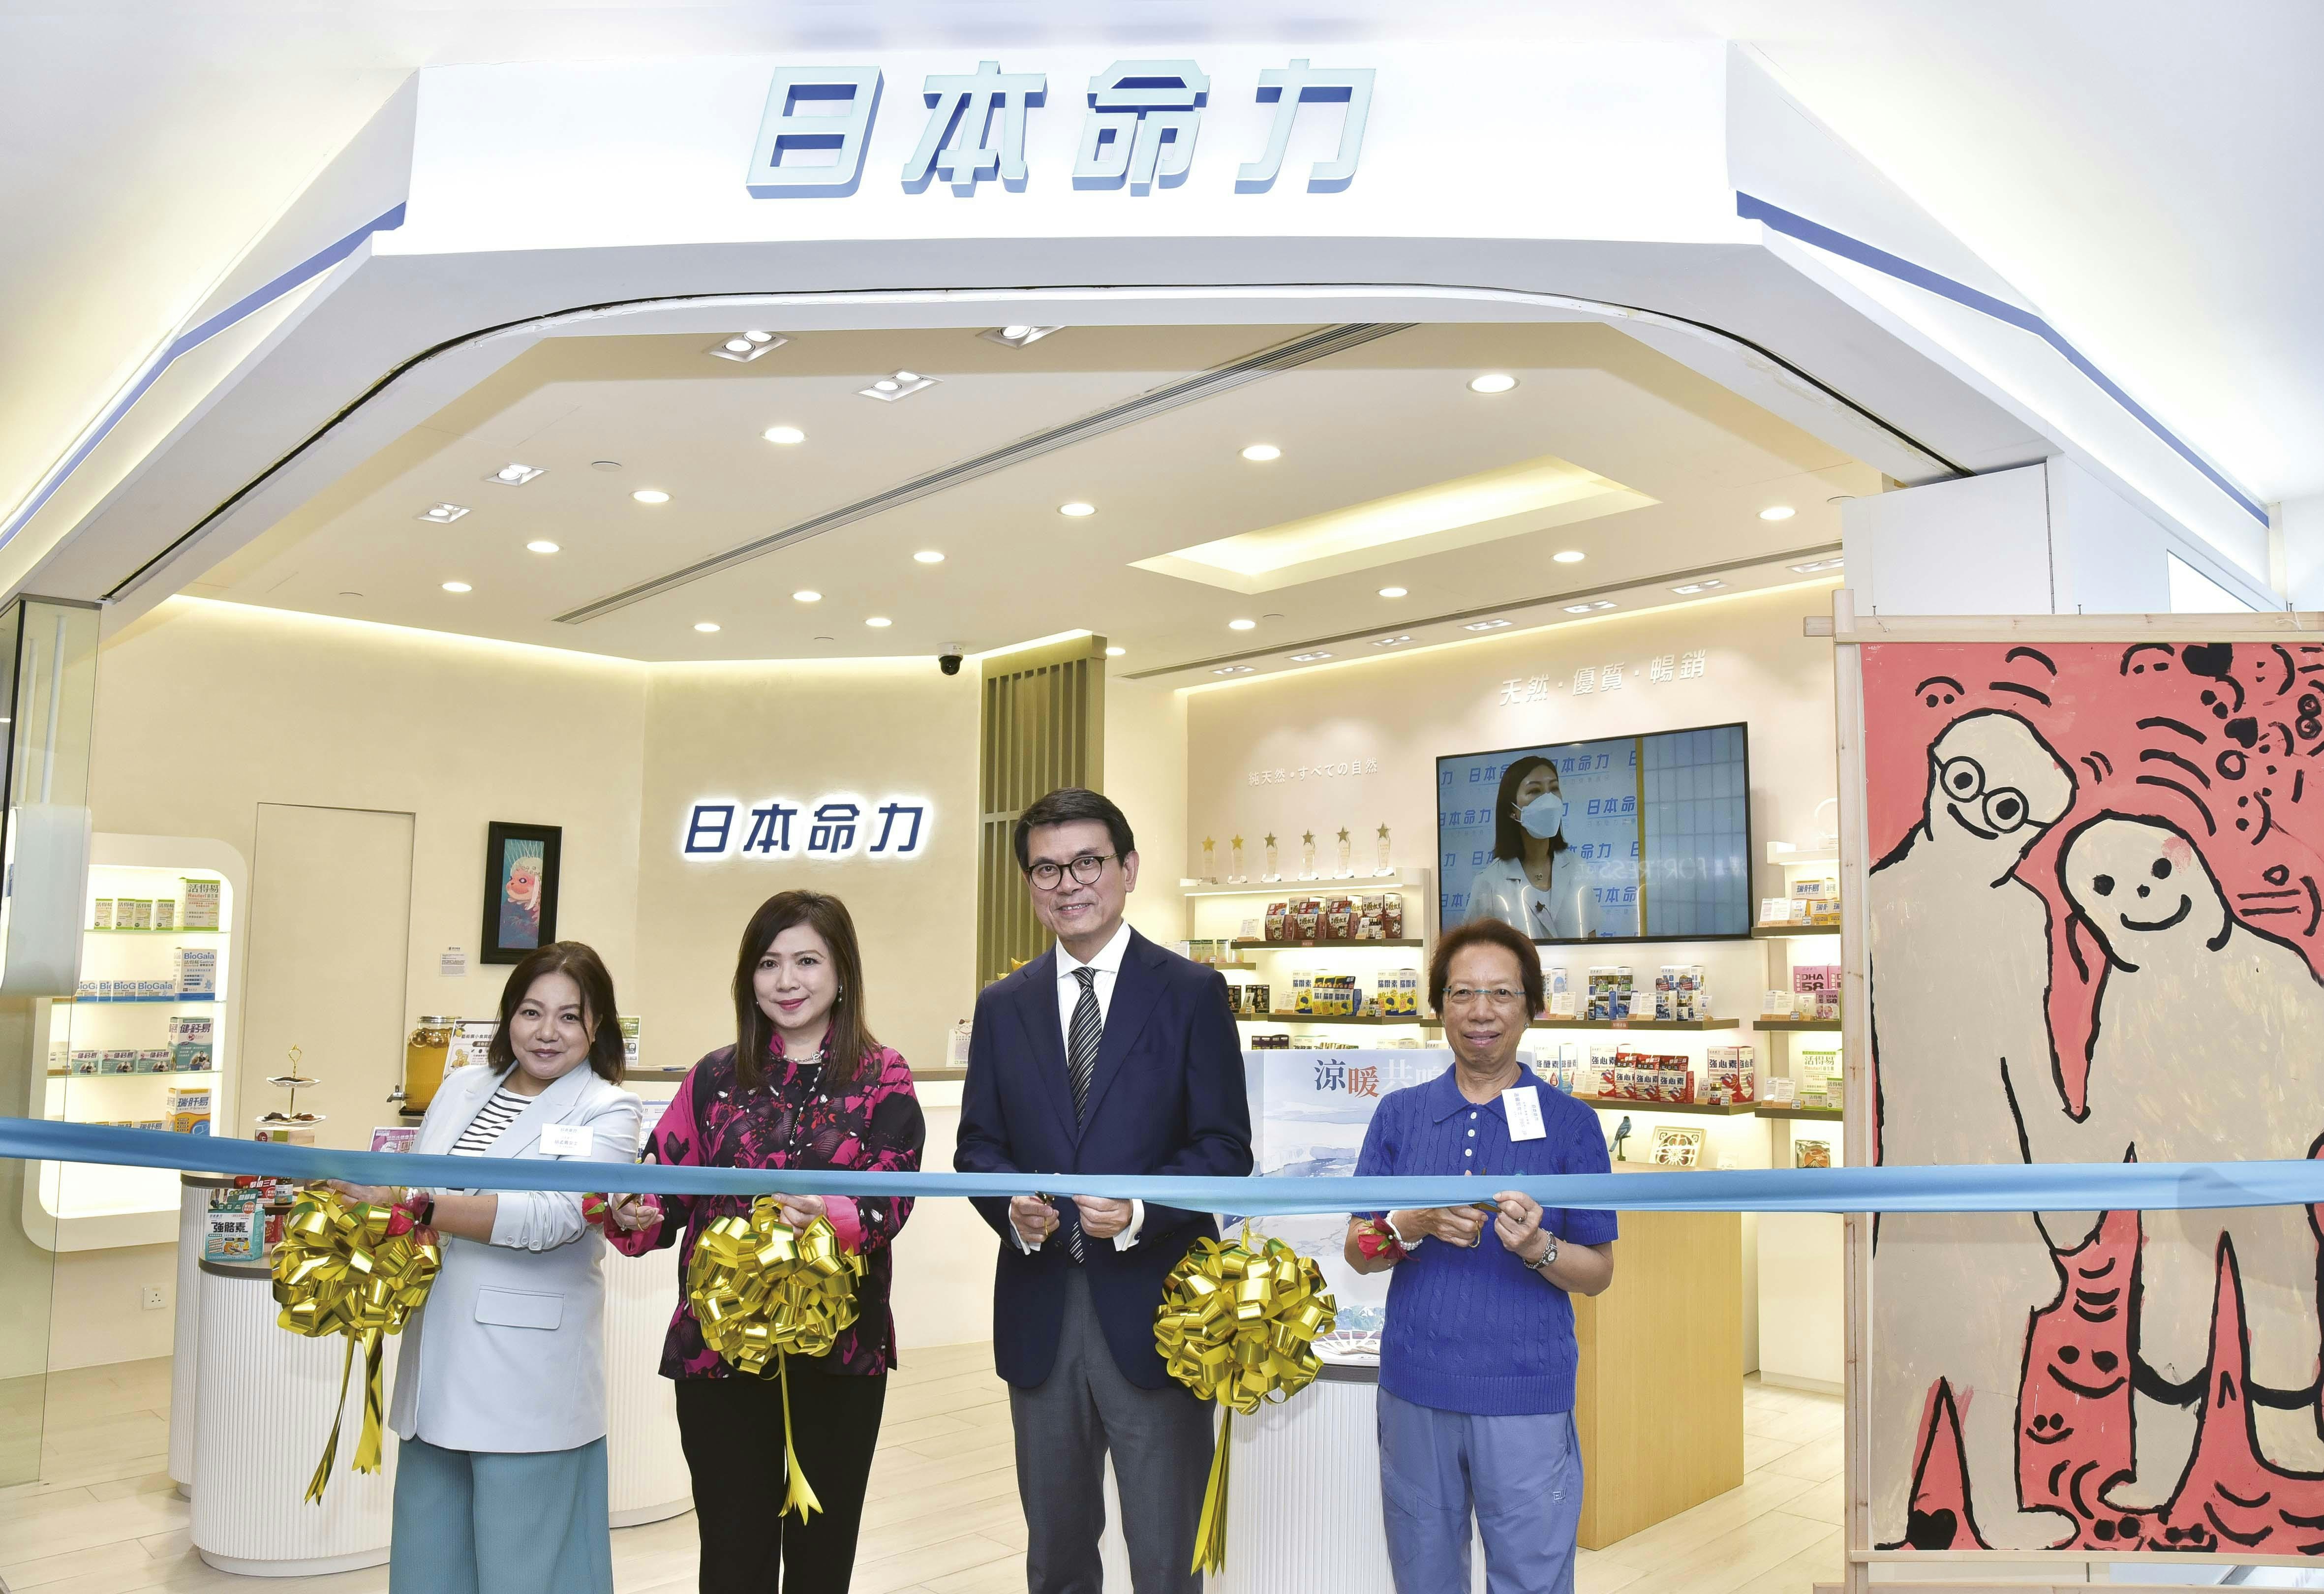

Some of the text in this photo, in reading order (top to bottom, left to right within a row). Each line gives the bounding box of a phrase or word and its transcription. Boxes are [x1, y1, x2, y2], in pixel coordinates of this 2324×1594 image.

[746, 59, 1376, 198] 日本命力
[684, 802, 924, 853] 日本命力
[138, 981, 173, 989] BioGaia
[1802, 982, 1824, 991] 58
[180, 1023, 212, 1033] 健鈣易
[1591, 1056, 1616, 1065] 強心素
[1710, 1059, 1737, 1069] 強心素
[1804, 1056, 1834, 1065] 活得易
[1660, 1077, 1684, 1085] 強心素
[177, 1096, 209, 1107] 瑞肝易
[211, 1222, 248, 1233] 強骼素
